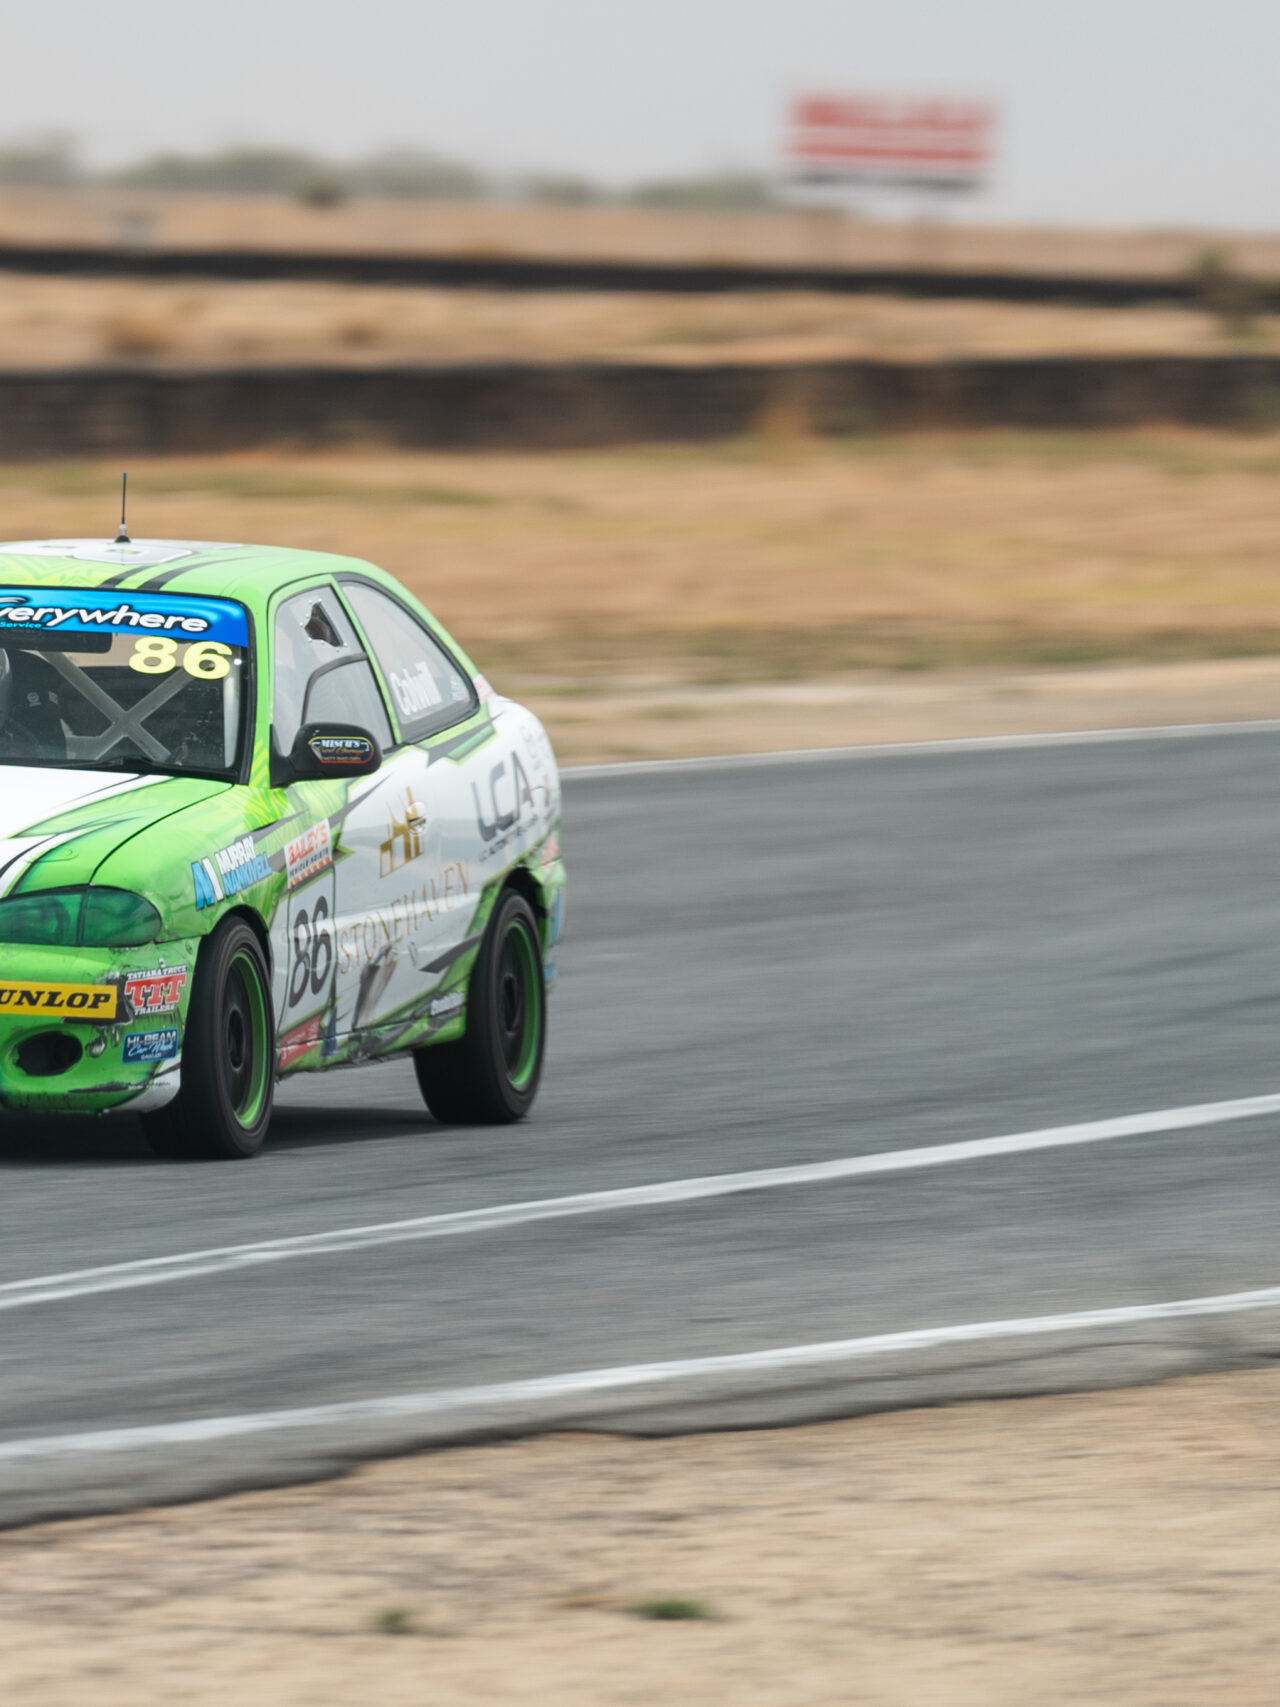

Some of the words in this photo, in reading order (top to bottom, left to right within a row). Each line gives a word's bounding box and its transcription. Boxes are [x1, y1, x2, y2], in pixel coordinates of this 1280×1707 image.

[0, 621, 43, 630] Service
[128, 637, 232, 680] 86
[214, 835, 256, 875] MURRAY
[289, 896, 332, 1008] 86
